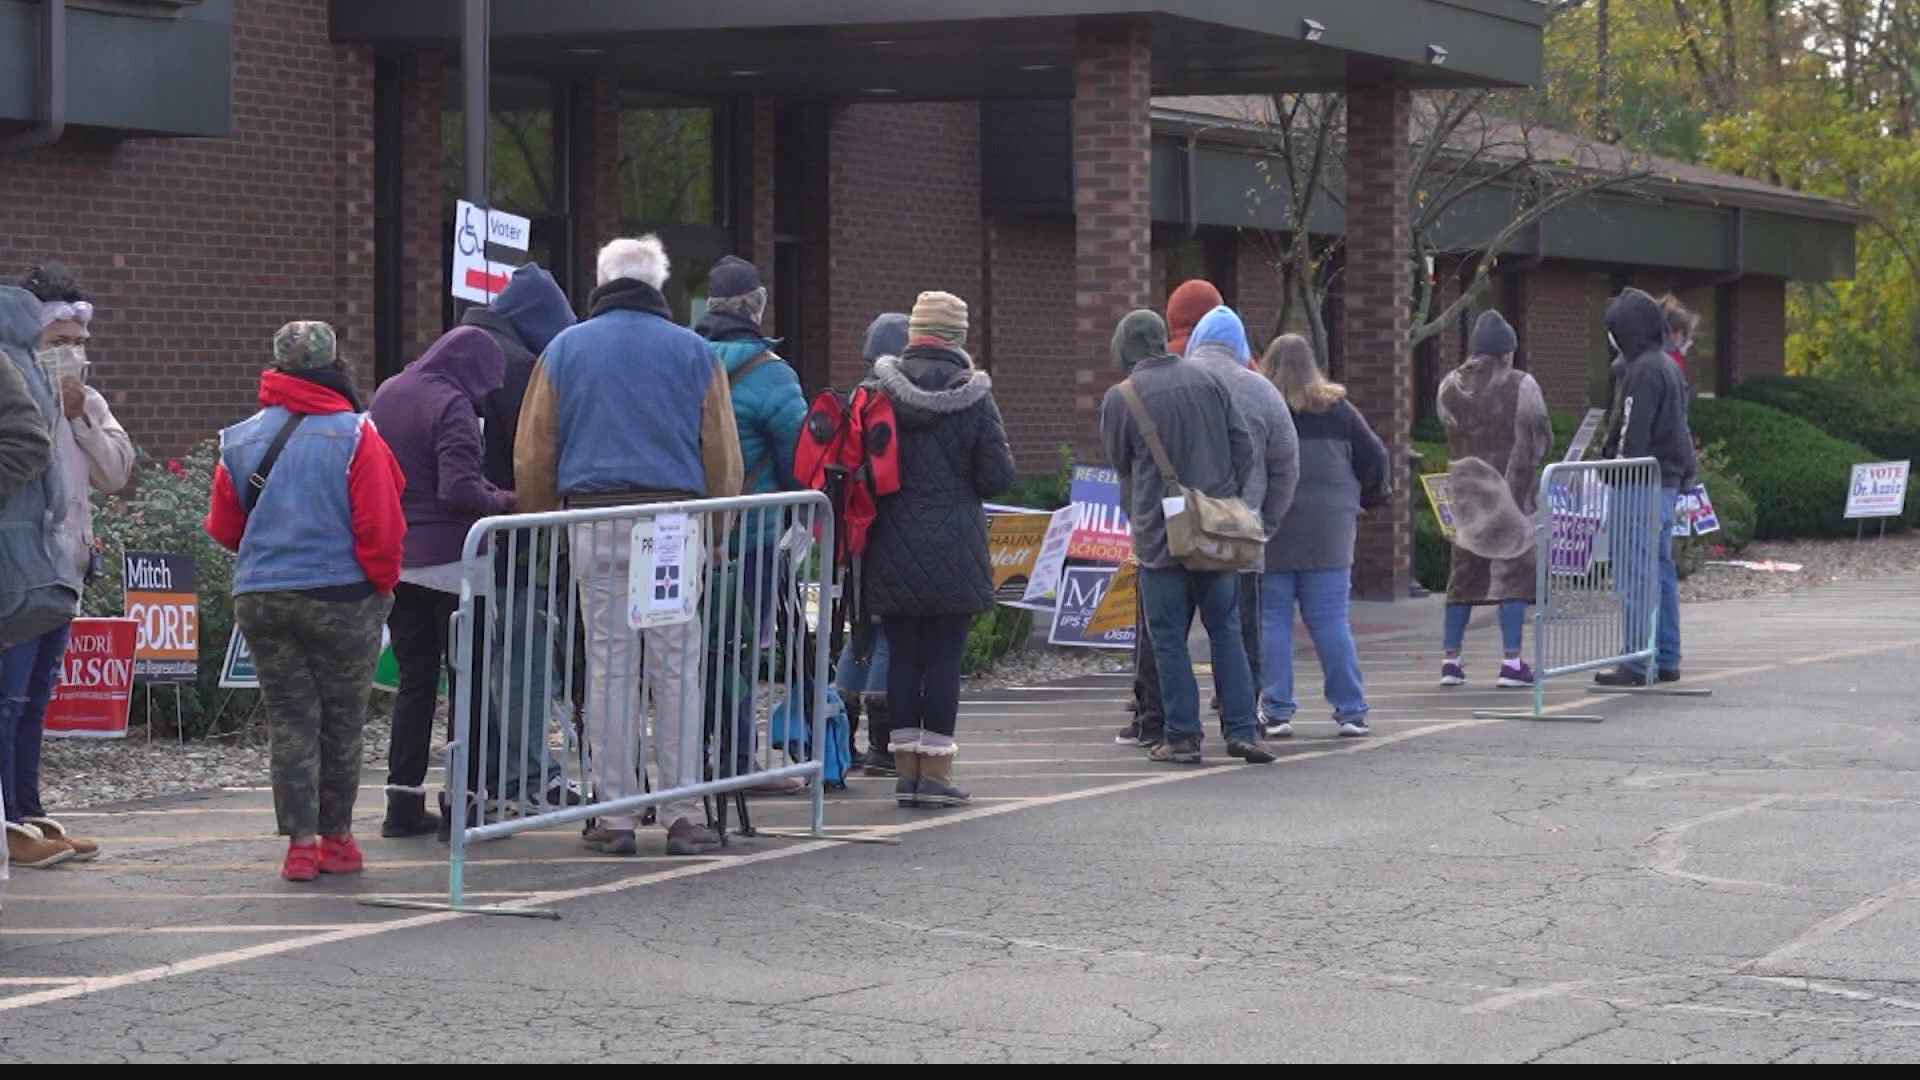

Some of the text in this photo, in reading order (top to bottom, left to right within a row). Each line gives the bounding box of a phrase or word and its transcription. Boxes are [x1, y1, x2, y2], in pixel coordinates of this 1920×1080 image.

[490, 216, 521, 240] Voter
[1871, 466, 1903, 480] VOTE
[991, 534, 1042, 546] HAUNA
[1070, 544, 1122, 558] SCHOOL
[127, 557, 172, 589] Mitch
[130, 603, 197, 650] GORE
[57, 656, 132, 687] ARSON
